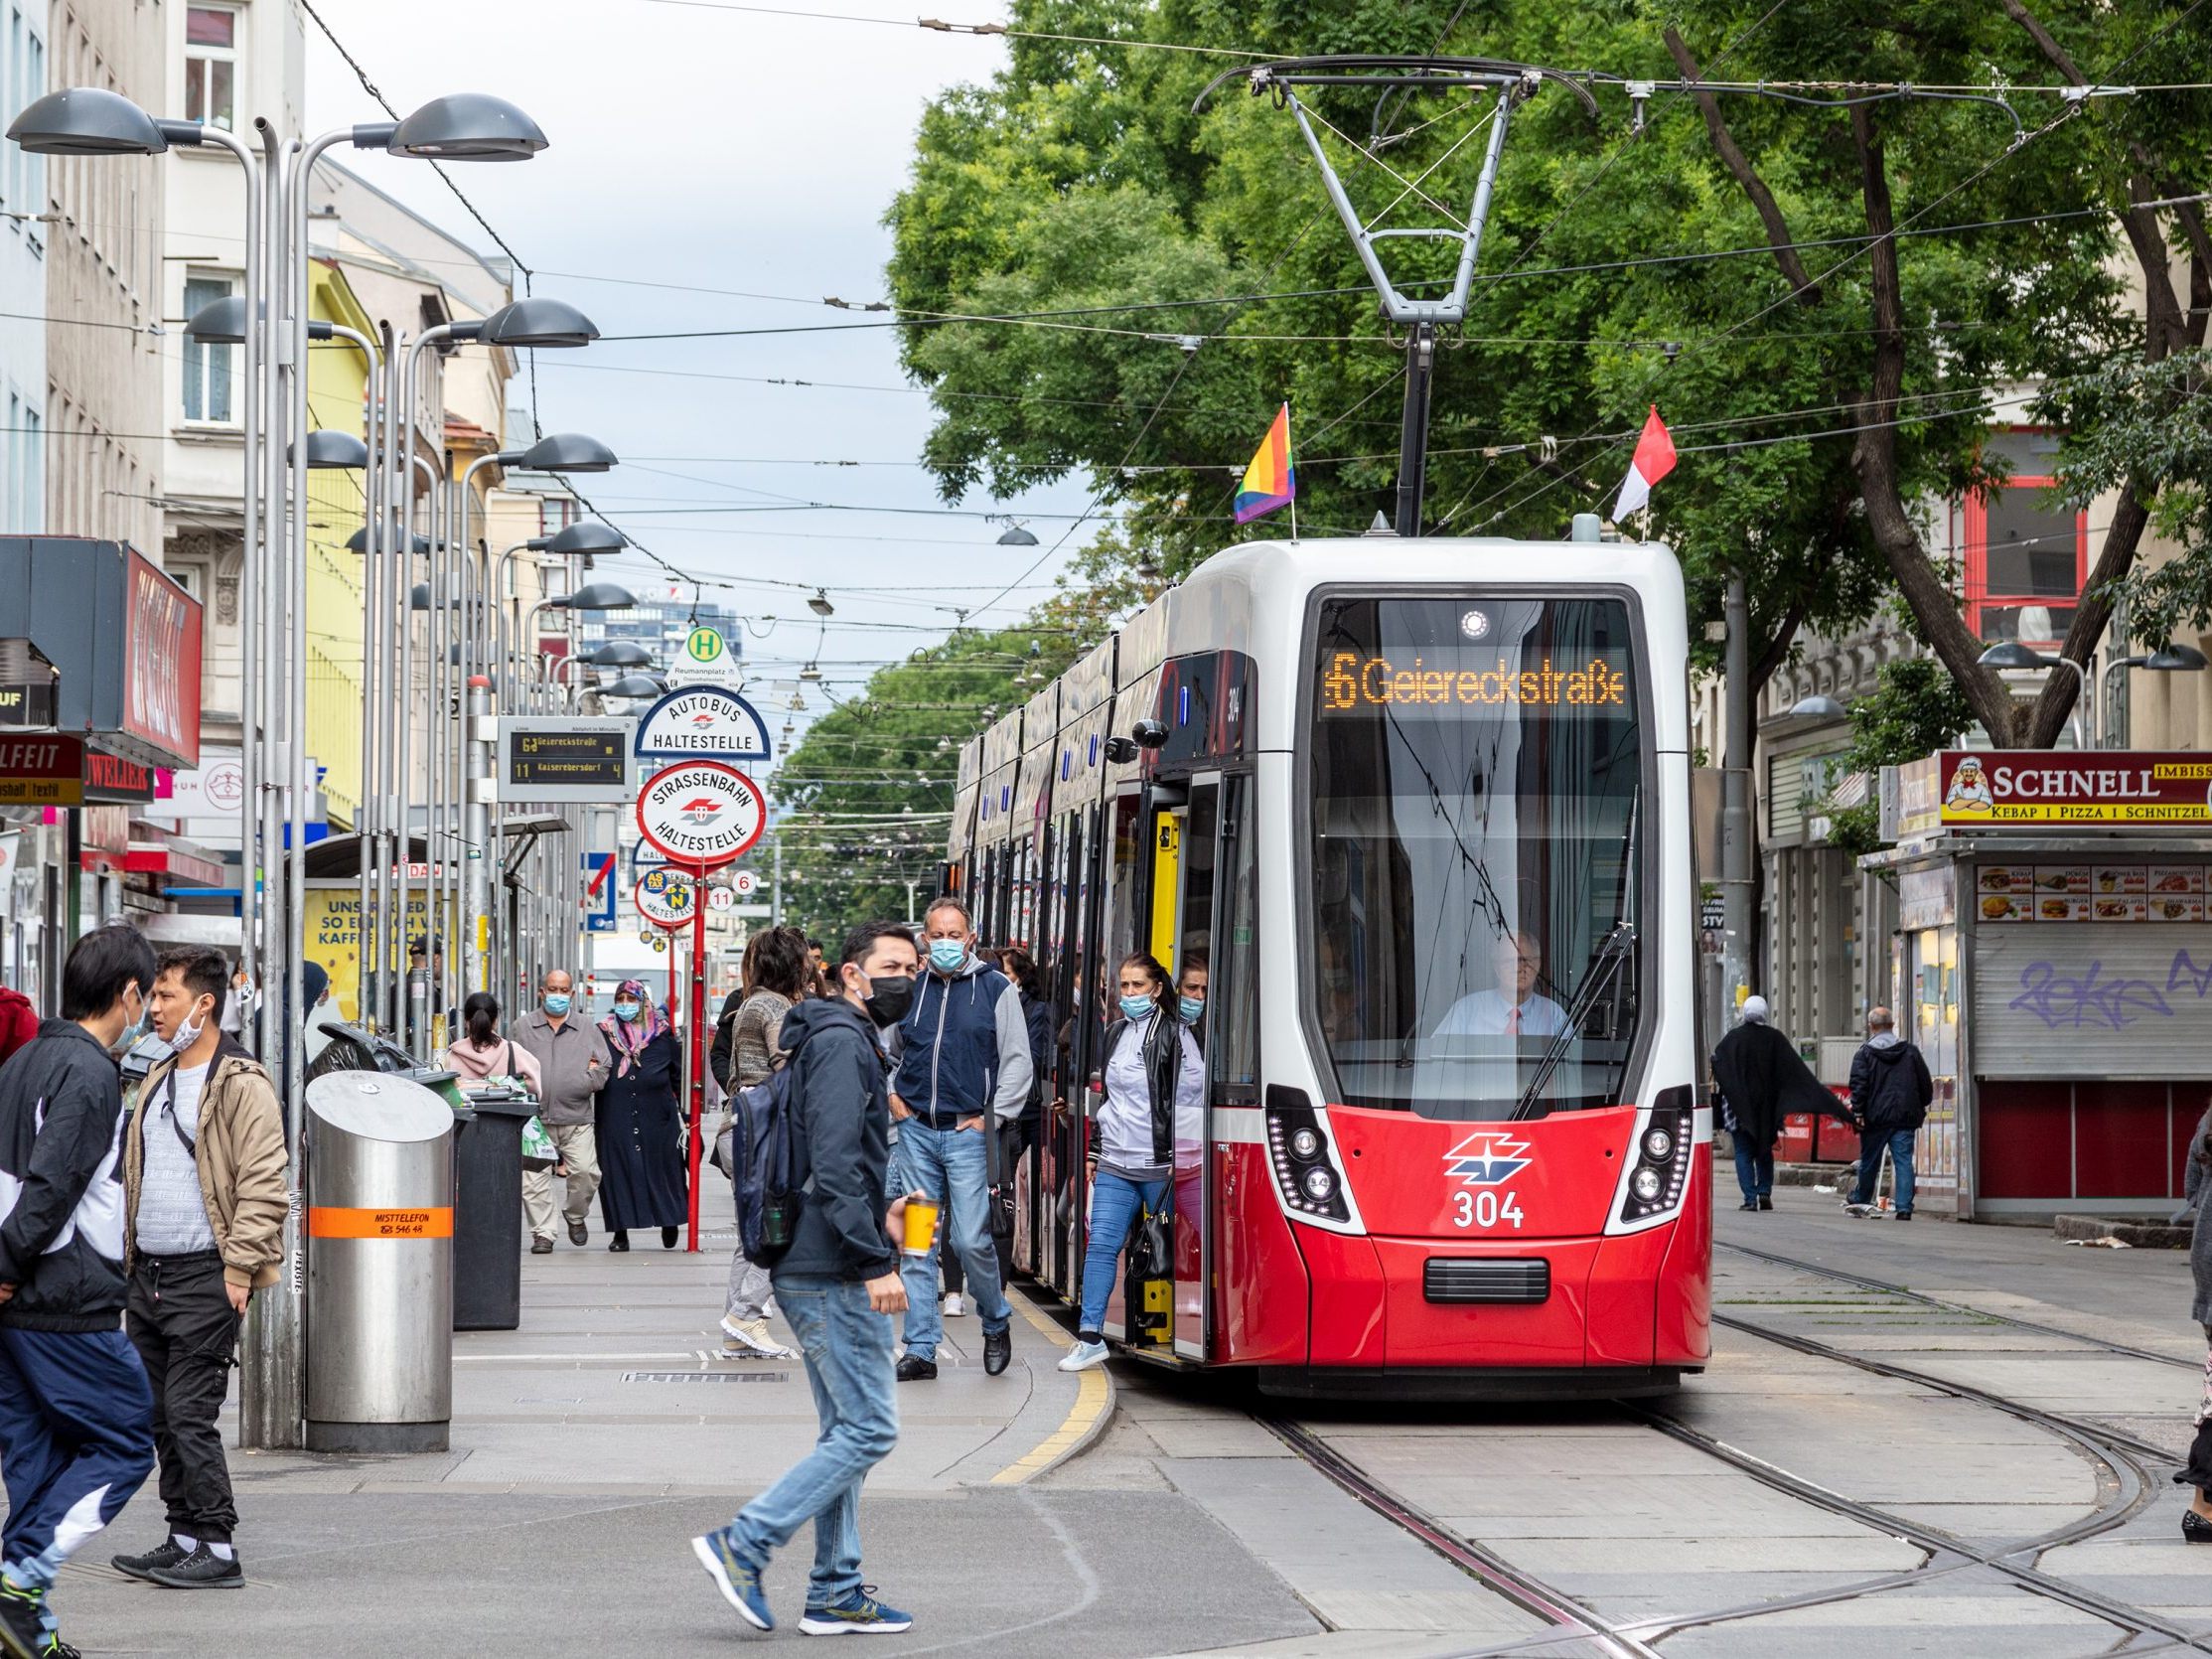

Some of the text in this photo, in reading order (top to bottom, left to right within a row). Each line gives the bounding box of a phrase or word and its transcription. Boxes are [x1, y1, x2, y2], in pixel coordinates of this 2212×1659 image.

[696, 635, 713, 656] H
[1362, 659, 1624, 704] Geiereckstraße
[668, 696, 741, 722] AUTOBUS
[654, 734, 752, 750] HALTESTELLE
[516, 763, 528, 778] 11
[613, 764, 621, 778] 4
[653, 773, 752, 807] STRASSENBAHN
[1993, 767, 2161, 798] SCHNELL
[1991, 806, 2037, 819] KEBAP
[2060, 807, 2104, 819] PIZZA
[2126, 806, 2208, 819] SCHNITZEL
[656, 822, 747, 851] HALTESTELLE
[739, 876, 749, 889] 6
[671, 894, 683, 907] N
[714, 893, 729, 905] 11
[322, 917, 343, 929] SO
[1453, 1190, 1525, 1229] 304
[374, 1213, 429, 1223] MISTTELEFON
[395, 1225, 411, 1234] 546
